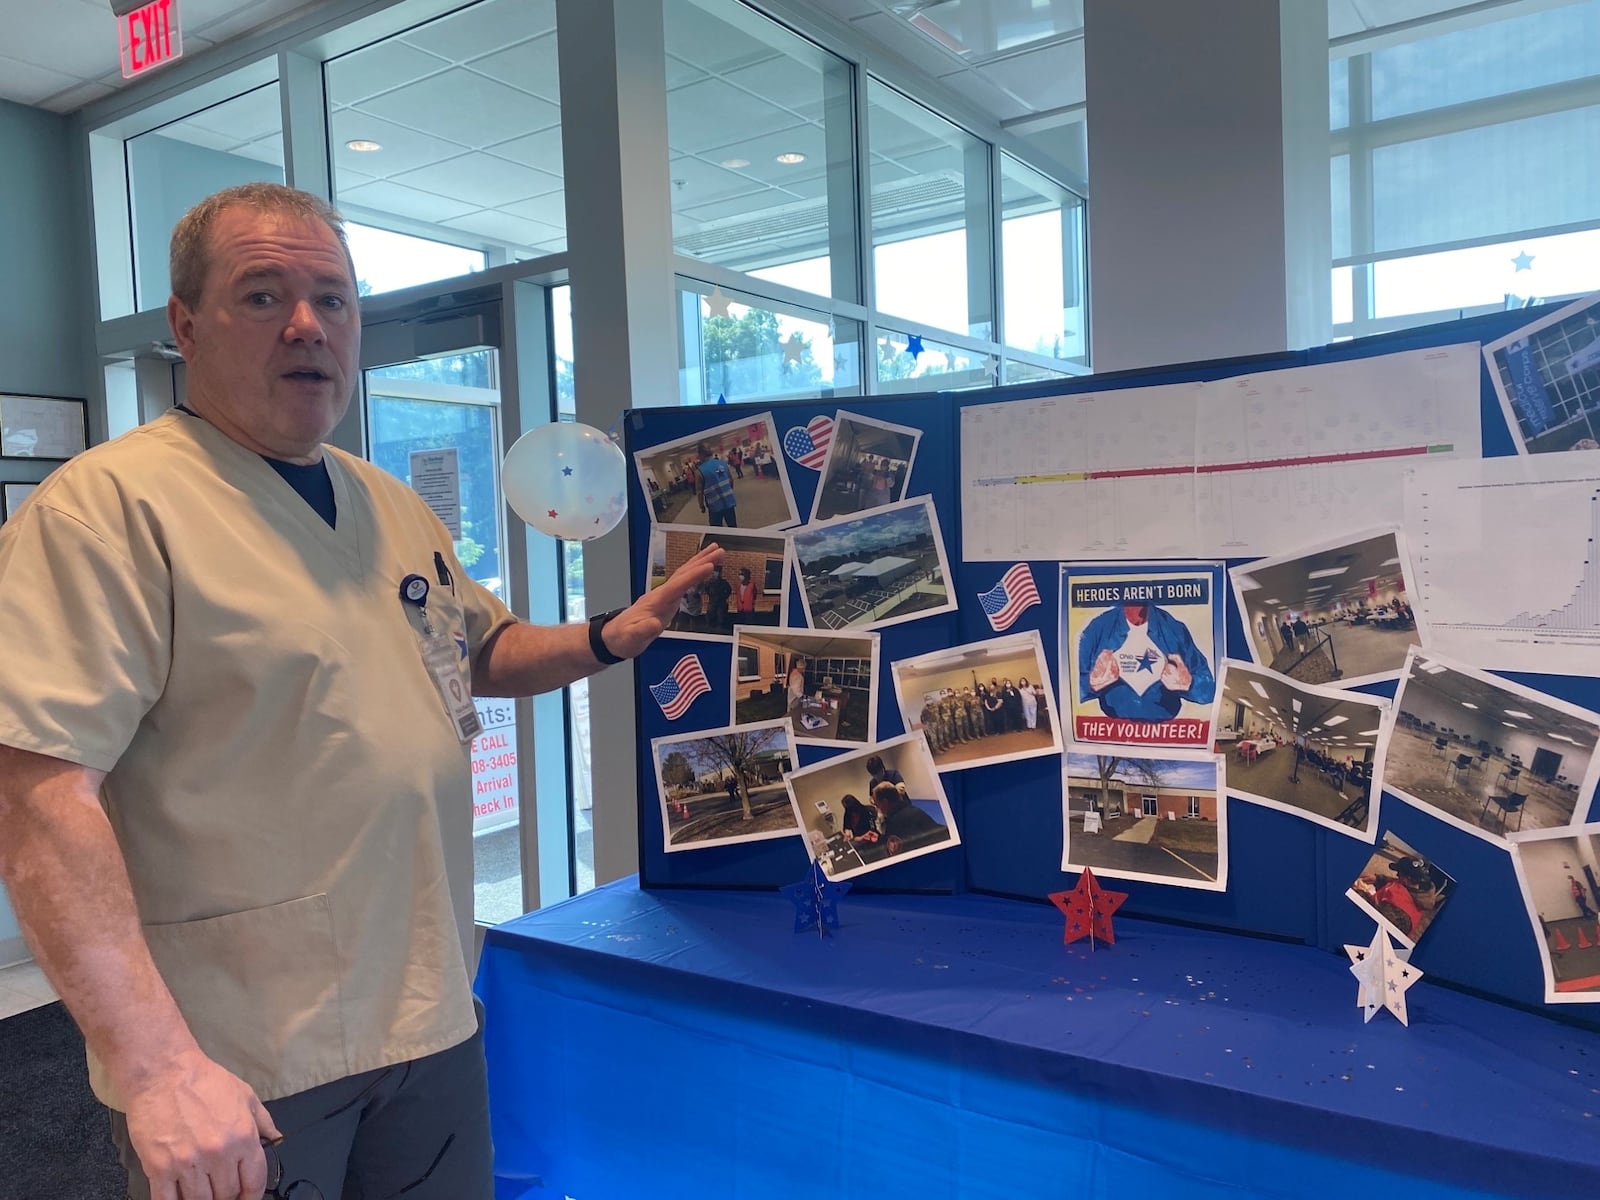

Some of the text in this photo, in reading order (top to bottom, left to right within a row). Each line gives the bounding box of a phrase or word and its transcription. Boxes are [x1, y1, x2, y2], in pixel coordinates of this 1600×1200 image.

[128, 0, 171, 71] EXIT
[1076, 583, 1201, 602] HEROES AREN'T BORN
[1082, 722, 1204, 739] THEY VOLUNTEER!
[481, 734, 508, 751] CALL
[477, 773, 512, 794] Arrival
[503, 795, 514, 809] In
